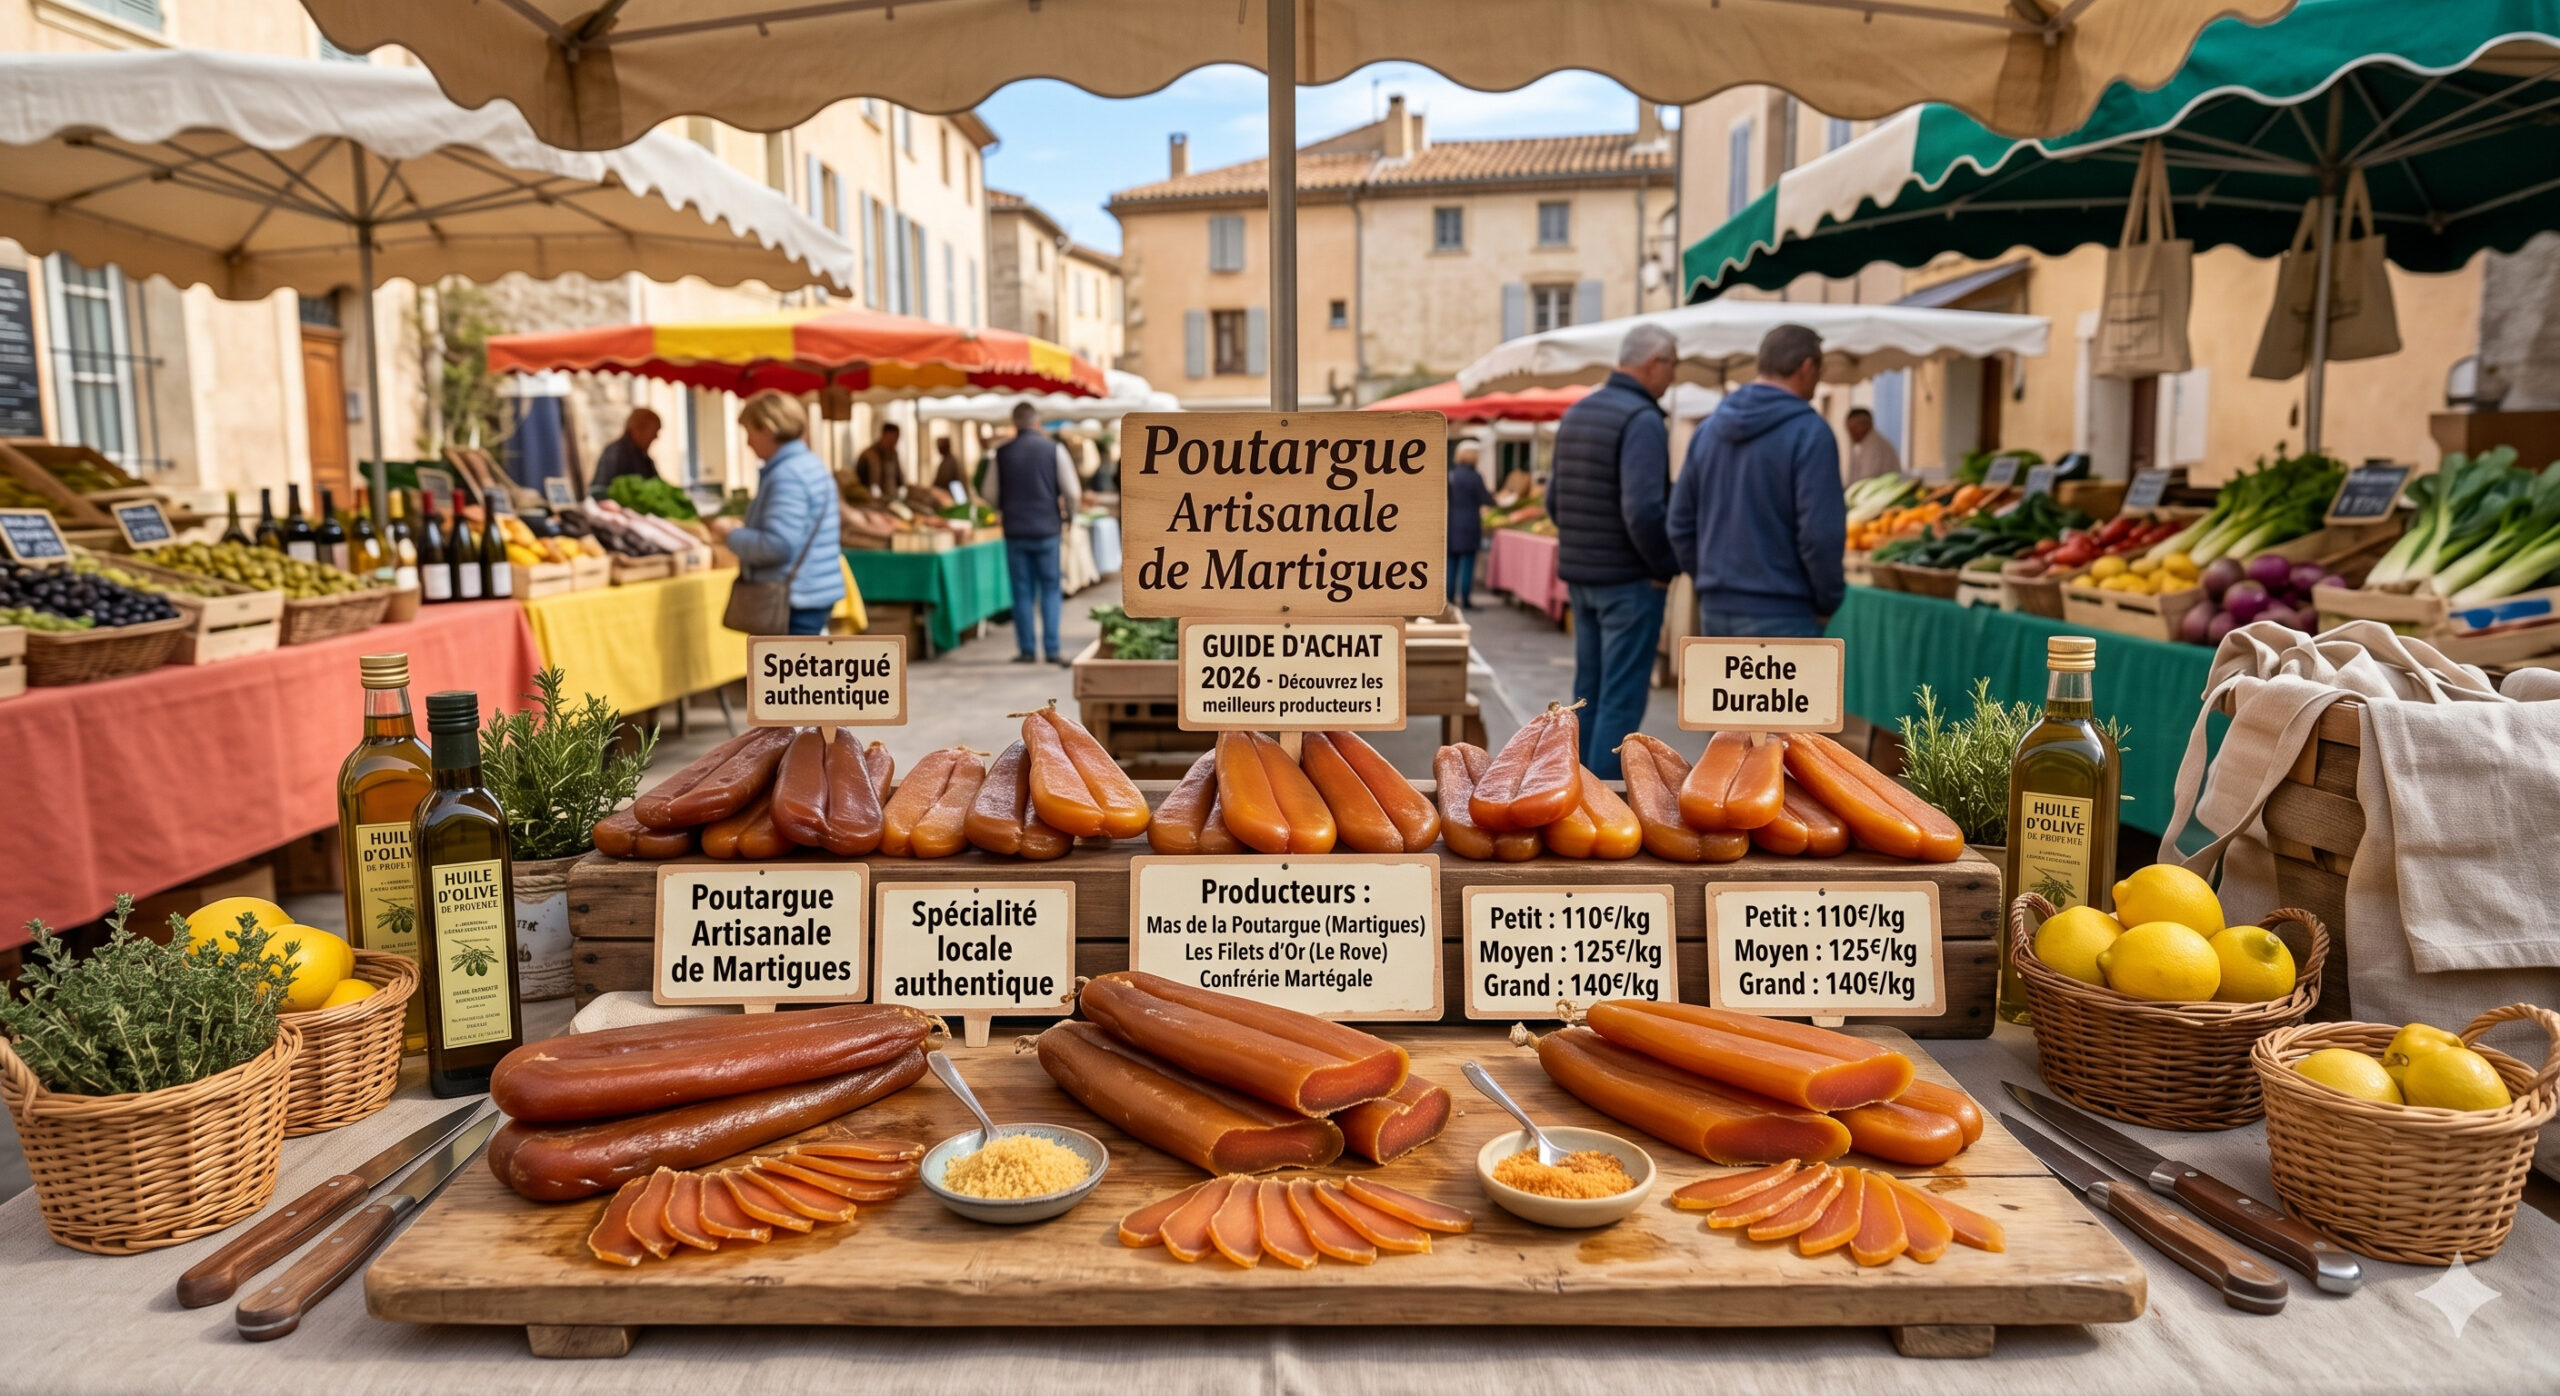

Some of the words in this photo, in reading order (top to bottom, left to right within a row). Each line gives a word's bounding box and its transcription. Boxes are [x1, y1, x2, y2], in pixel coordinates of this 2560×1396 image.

[1139, 422, 1427, 492] Poutargue
[1165, 488, 1399, 533] Artisanale
[1138, 546, 1190, 590] de
[1200, 547, 1428, 603] Martigues
[1202, 634, 1275, 658] GUIDE
[1282, 634, 1383, 658] D'ACHAT
[763, 652, 891, 684] Spétargué
[1201, 665, 1261, 690] 2026
[1278, 673, 1358, 690] Découvrez
[1361, 672, 1384, 689] les
[1725, 654, 1797, 681] Pêche
[764, 684, 890, 711] authentique
[1203, 696, 1276, 713] meilleurs
[1279, 696, 1372, 717] producteurs
[1712, 687, 1809, 713] Durable
[2034, 801, 2080, 819] HUILE
[370, 830, 412, 845] HUIL
[2026, 817, 2085, 836] D'OLIVE
[2027, 832, 2038, 840] DE
[364, 846, 412, 862] D'OLIV
[444, 869, 493, 886] HUILE
[1202, 877, 1356, 905] Producteurs
[438, 884, 499, 904] D'OLIVE
[692, 883, 834, 918] Poutargue
[441, 906, 452, 914] DE
[911, 899, 1037, 935] Spécialité
[1490, 905, 1543, 930] Petit
[1561, 905, 1650, 936] 110€/kg
[1745, 903, 1798, 928] Petit
[1816, 903, 1905, 934] 110€/kg
[691, 917, 832, 947] Artisanale
[1147, 915, 1182, 934] Mas
[1186, 914, 1207, 934] de
[1212, 914, 1227, 934] la
[1232, 915, 1321, 939] Poutargue
[1325, 914, 1426, 939] (Martigues)
[938, 934, 1013, 962] locale
[1185, 943, 1213, 961] Les
[1218, 941, 1265, 961] Filets
[1309, 941, 1335, 964] (Le
[1340, 941, 1388, 964] Rove)
[1480, 940, 1554, 969] Moyen
[1574, 938, 1662, 969] 125€/kg
[1735, 938, 1809, 967] Moyen
[1829, 937, 1917, 968] 125€/kg
[671, 954, 704, 983] de
[713, 953, 851, 989] Martigues
[1200, 968, 1280, 988] Confrérie
[1285, 968, 1373, 993] Martégale
[894, 968, 1054, 1004] authentique
[1484, 972, 1550, 997] Grand
[1570, 971, 1659, 1002] 140€/kg
[1739, 970, 1806, 996] Grand
[1825, 970, 1915, 1002] 140€/kg
